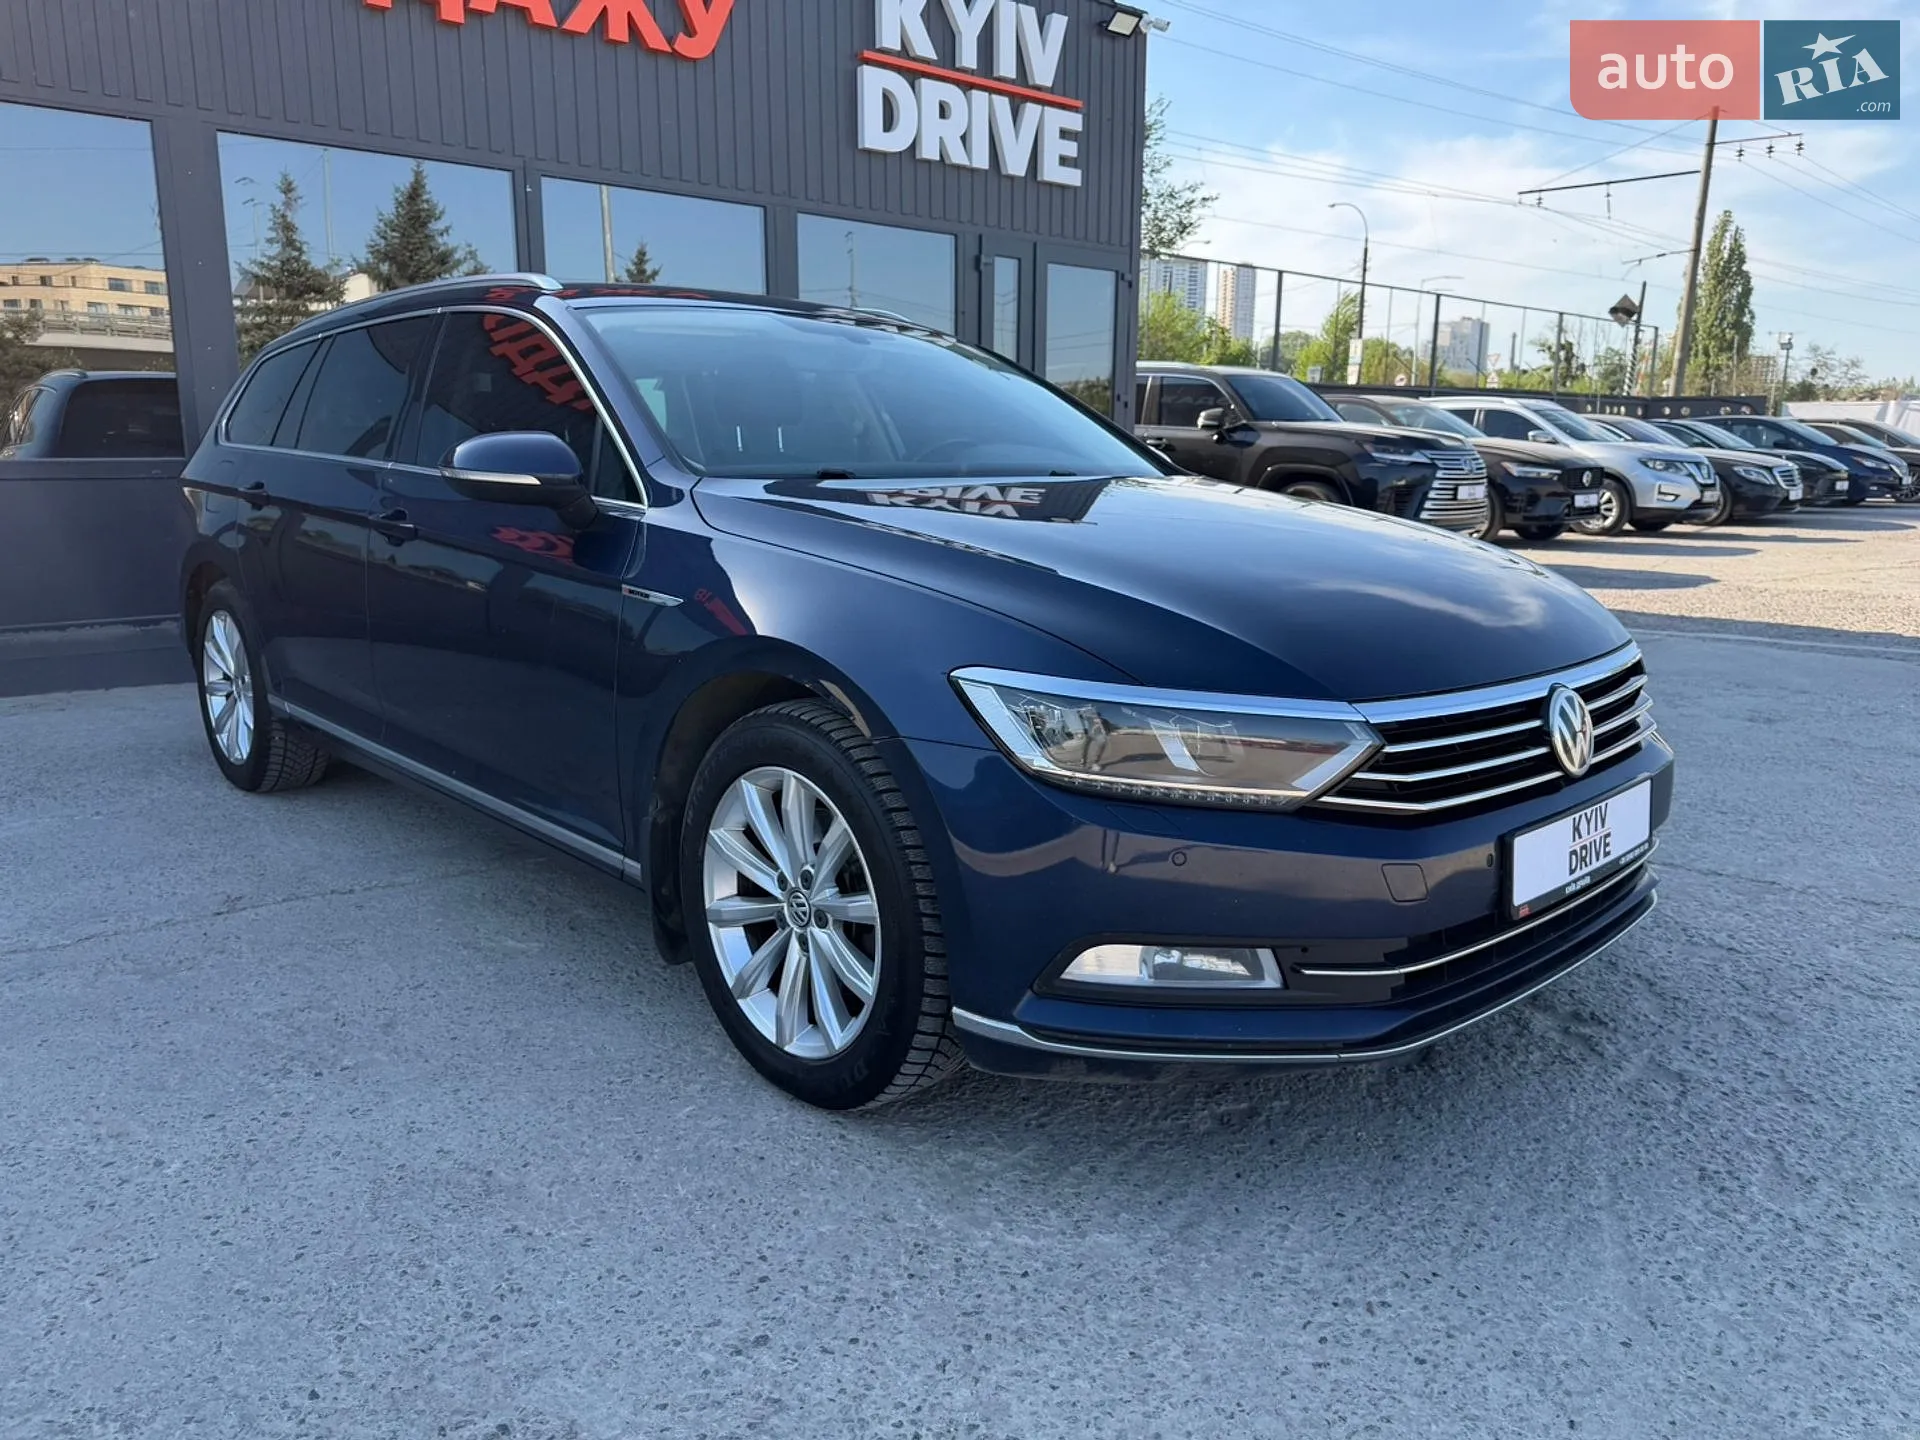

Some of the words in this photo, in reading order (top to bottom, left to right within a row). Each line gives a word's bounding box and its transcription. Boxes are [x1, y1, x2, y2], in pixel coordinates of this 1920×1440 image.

[875, 0, 1069, 88] KYIV
[857, 64, 1083, 187] DRIVE
[1569, 831, 1611, 876] DRIVE
[1572, 802, 1608, 843] KYIV
